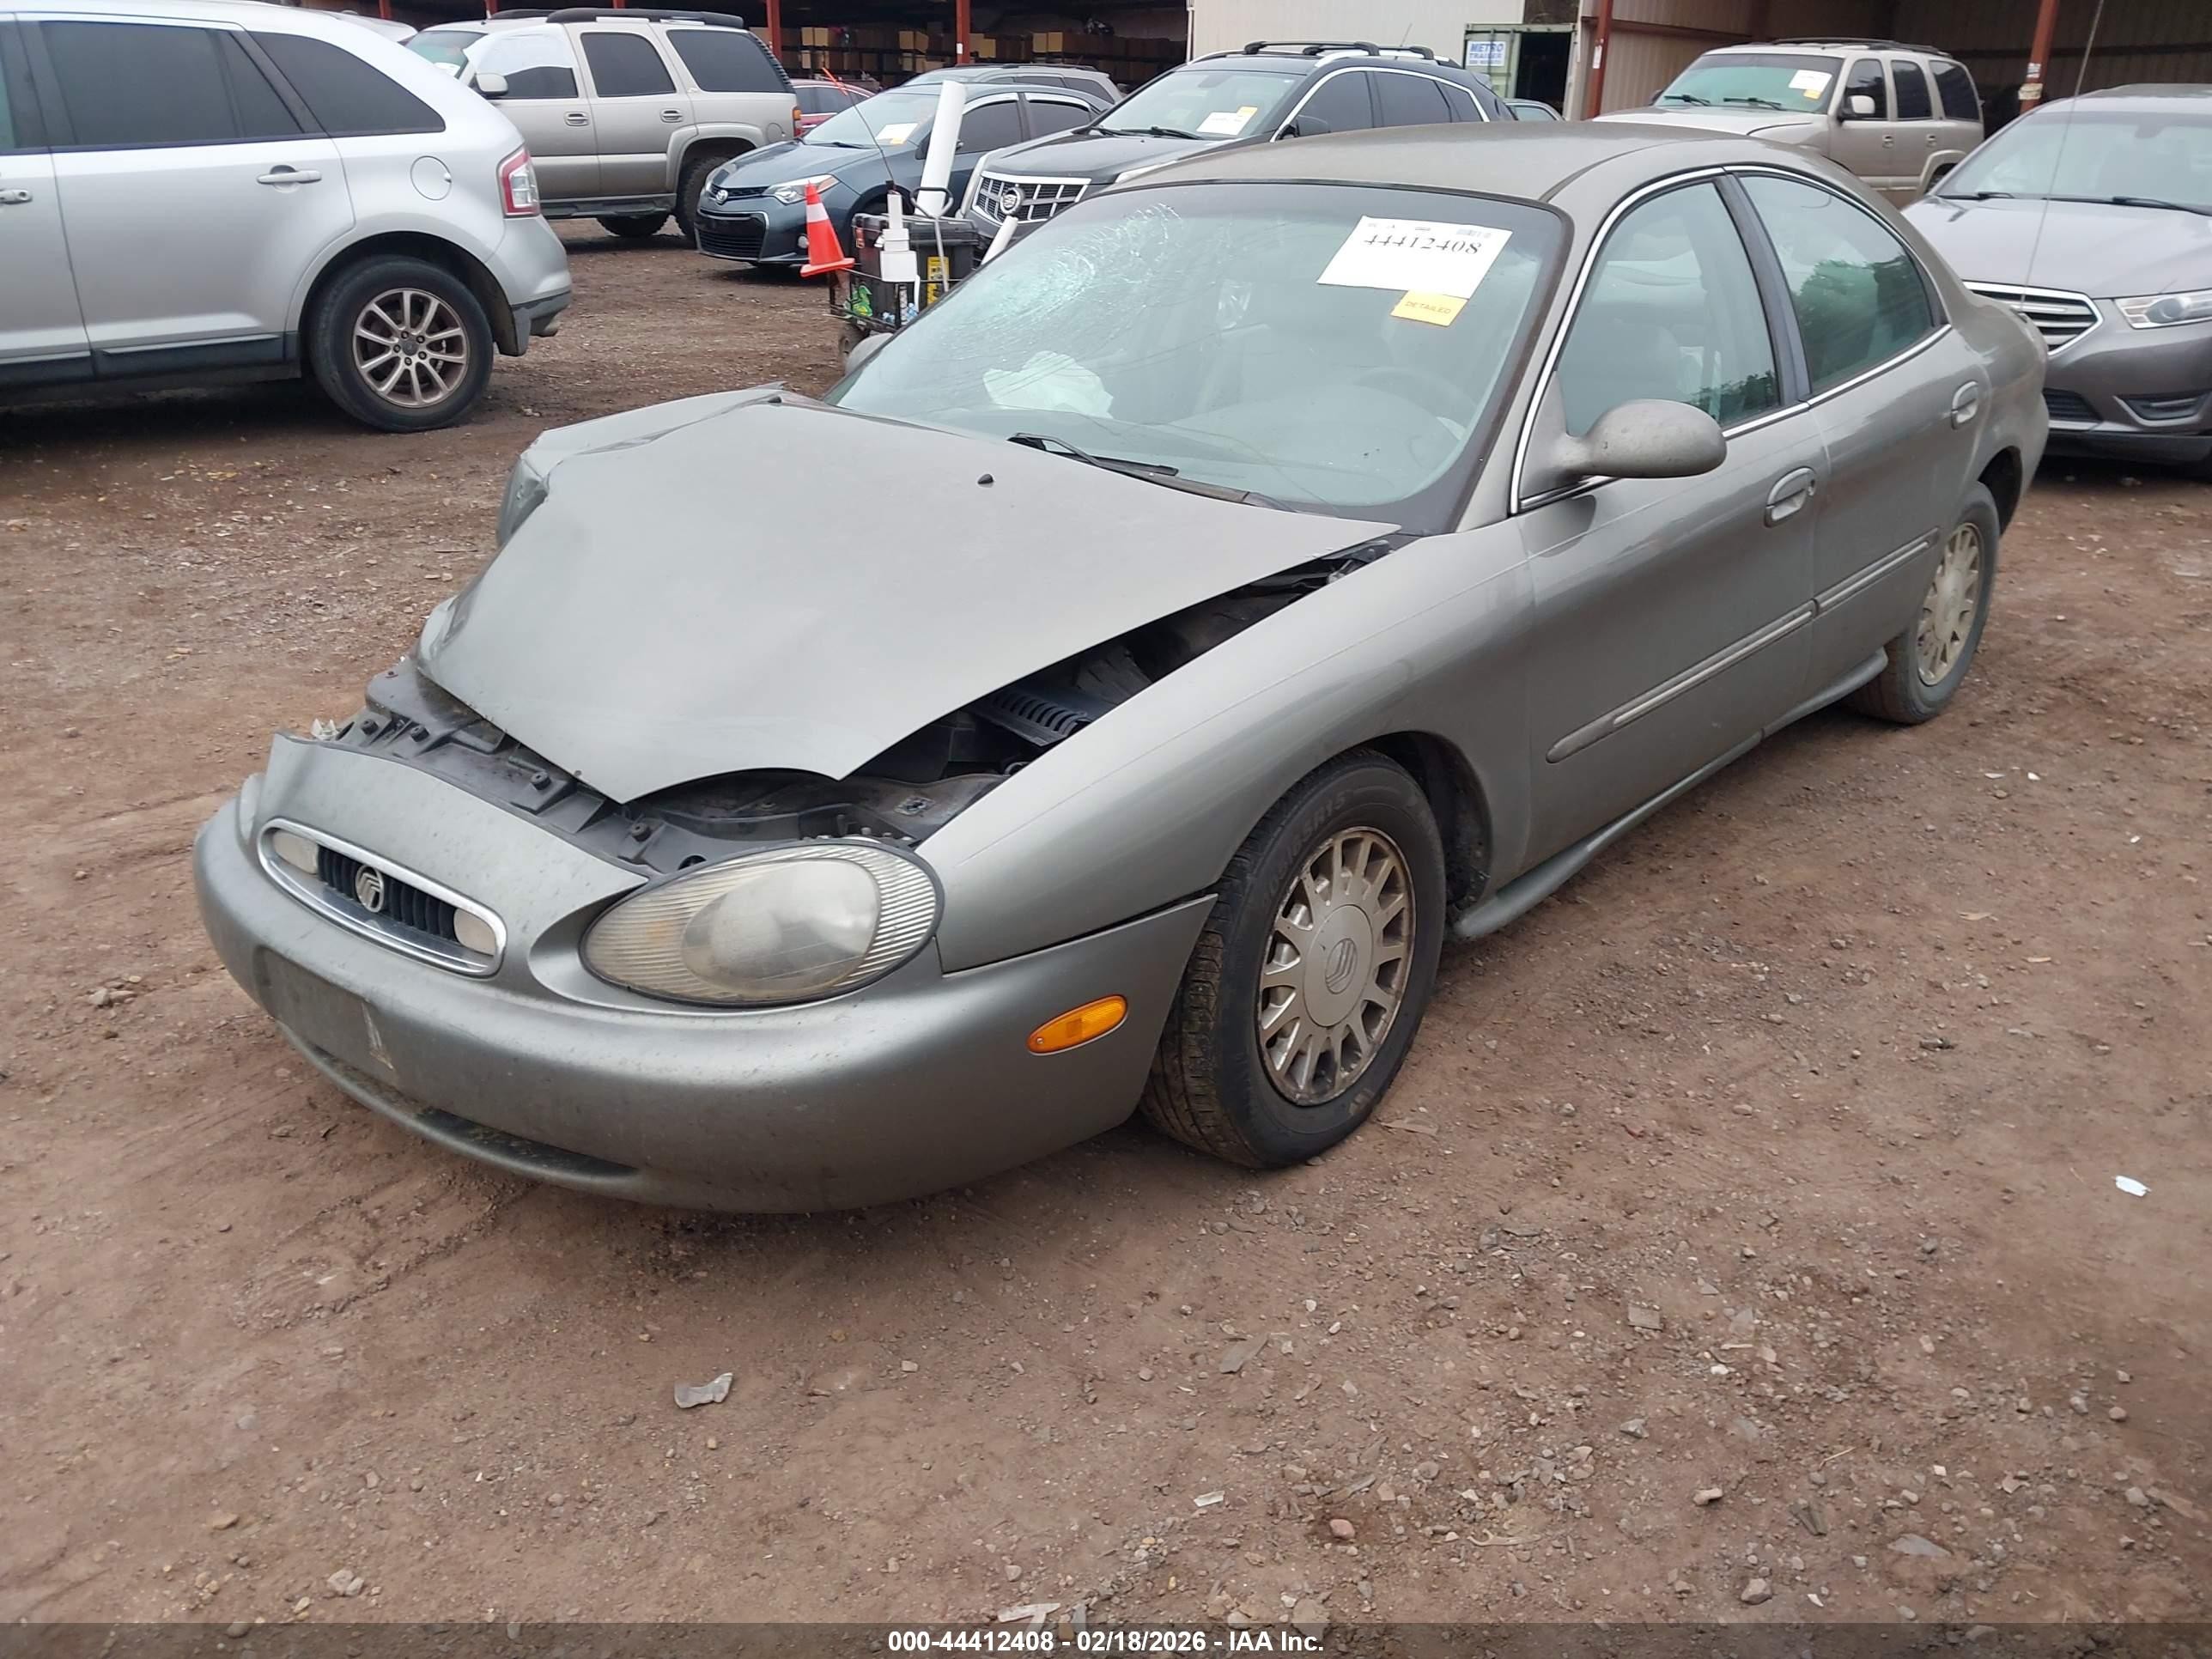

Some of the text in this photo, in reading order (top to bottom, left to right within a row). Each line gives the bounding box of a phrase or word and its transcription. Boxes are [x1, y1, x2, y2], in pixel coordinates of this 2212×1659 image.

[1470, 43, 1504, 52] METRO
[1364, 234, 1482, 254] 44412408
[1405, 301, 1452, 314] DETAILED
